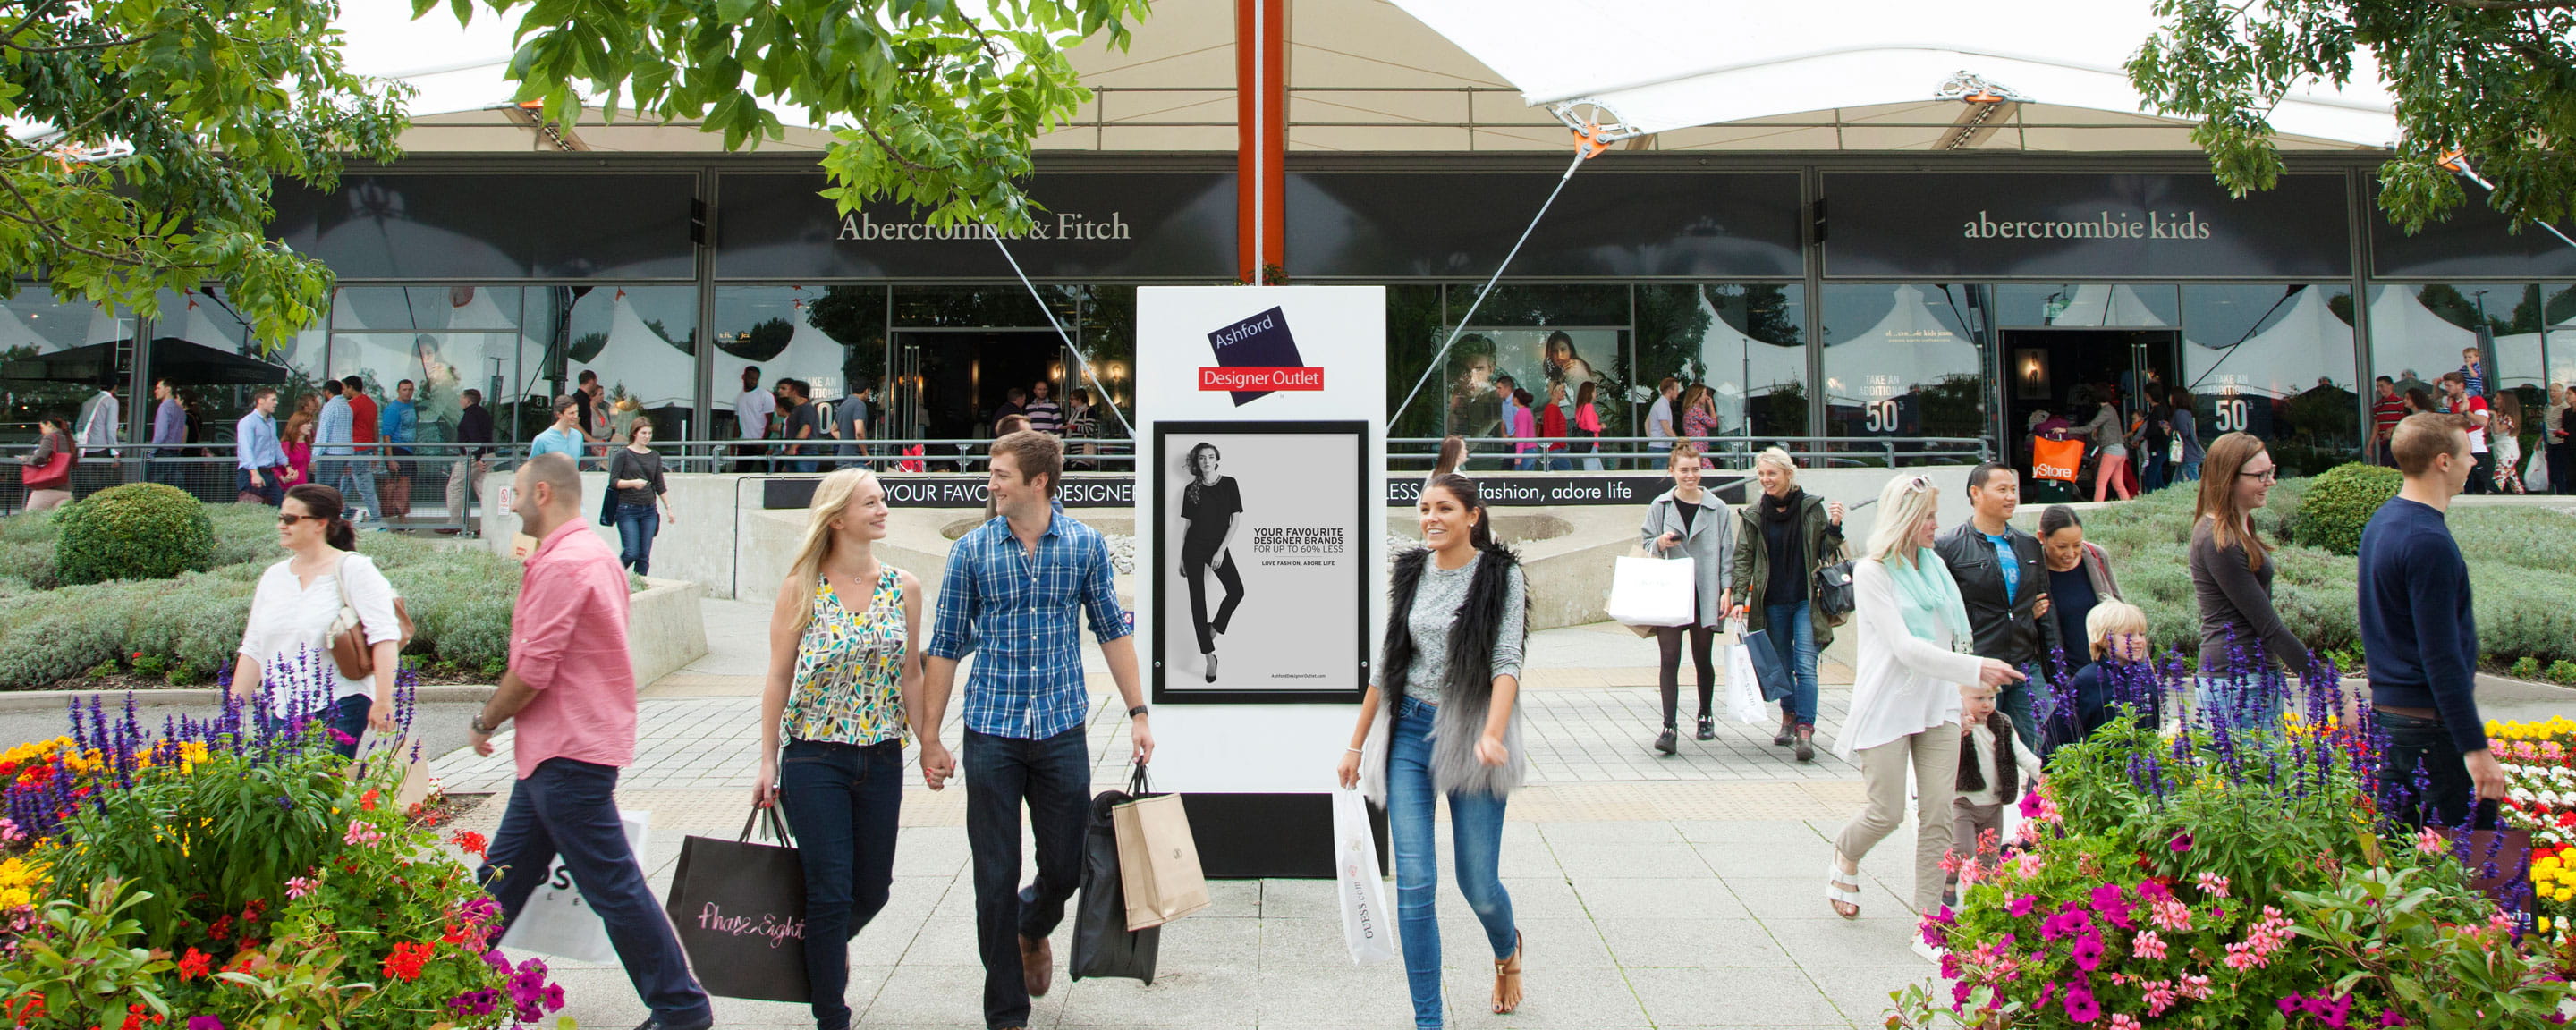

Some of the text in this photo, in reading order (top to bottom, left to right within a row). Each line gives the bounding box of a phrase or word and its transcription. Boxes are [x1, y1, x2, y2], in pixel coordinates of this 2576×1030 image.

[836, 212, 1131, 241] Abercromb & Fitch
[1963, 210, 2211, 240] abercrombie kids
[1216, 315, 1274, 350] Ashford
[1204, 369, 1319, 389] Designer Outlet
[1865, 375, 1900, 385] TAKE AN
[2214, 374, 2249, 384] TAKE AN
[883, 484, 937, 502] YOUR
[1056, 484, 1136, 502] ESIGNE
[1386, 481, 1632, 502] ESS fashion, adore life
[1254, 528, 1343, 536] YOUR FAVOURITE
[1254, 536, 1343, 545] DESIGNER BRANDS
[1253, 545, 1344, 553] FOR UP TO 60% LESS
[1353, 881, 1375, 939] GUESS.com
[698, 901, 806, 949] Phase Eight
